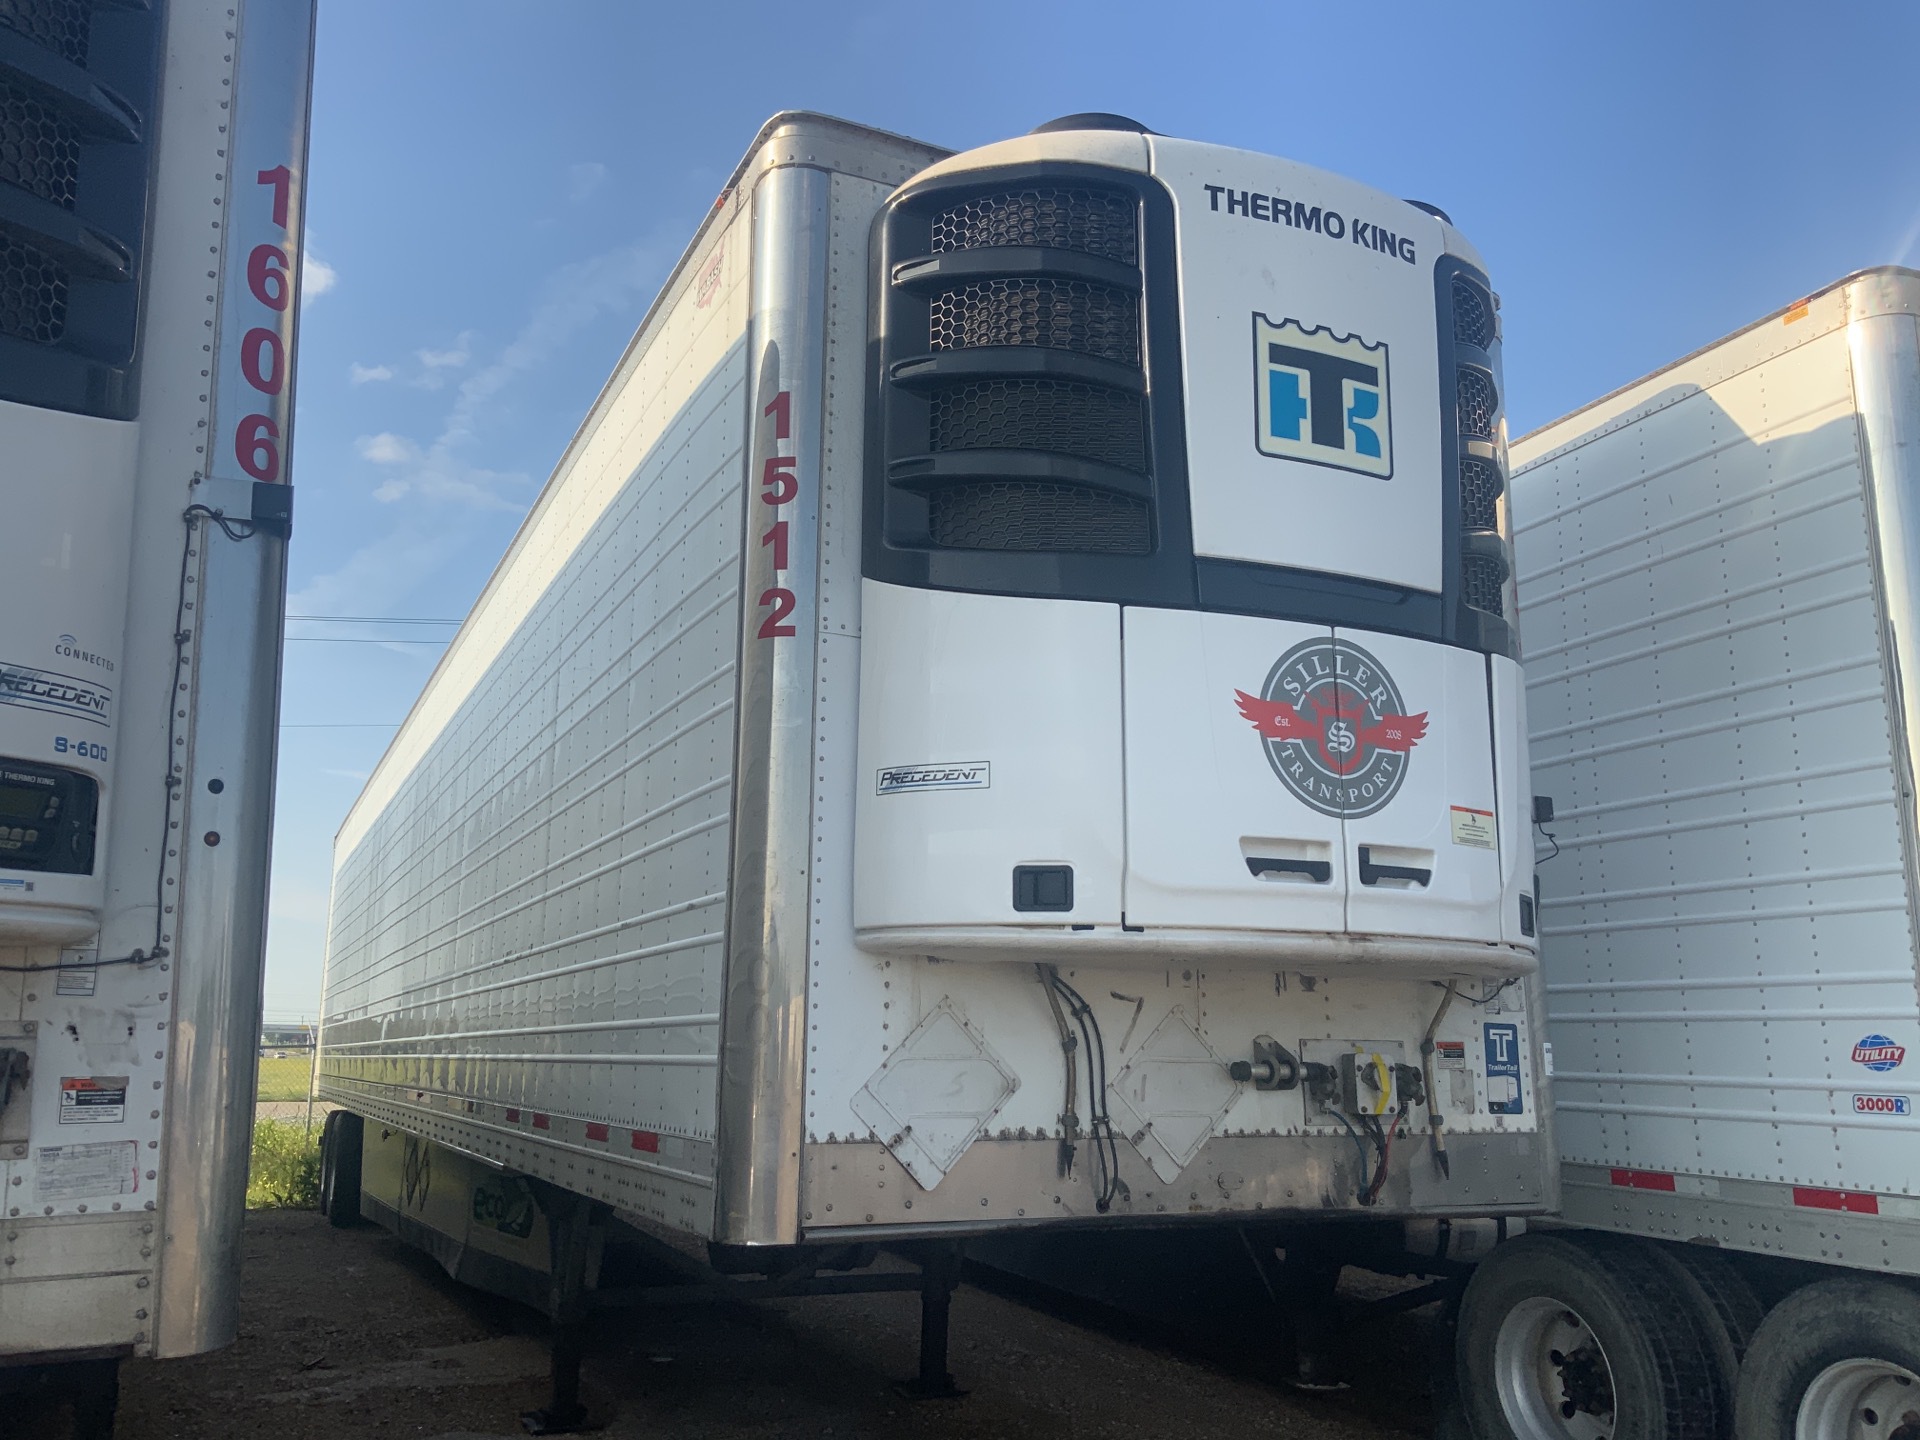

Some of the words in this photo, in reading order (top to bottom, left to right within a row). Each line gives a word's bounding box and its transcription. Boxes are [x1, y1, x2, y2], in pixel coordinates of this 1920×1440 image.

[1204, 183, 1345, 240] THERMO
[1352, 218, 1416, 265] KING
[235, 164, 290, 483] 1606
[757, 391, 799, 640] 1512
[55, 644, 114, 671] CONNECTED
[0, 668, 110, 710] RECEDENT
[1283, 655, 1387, 709] SILLER
[54, 736, 107, 762] S-600
[4, 771, 36, 783] THERMO
[36, 777, 55, 786] KING
[880, 768, 986, 786] PRECEDENT
[1281, 744, 1393, 803] TRANSPORT
[1854, 1048, 1902, 1061] UTILITY
[1856, 1096, 1905, 1113] 3000R
